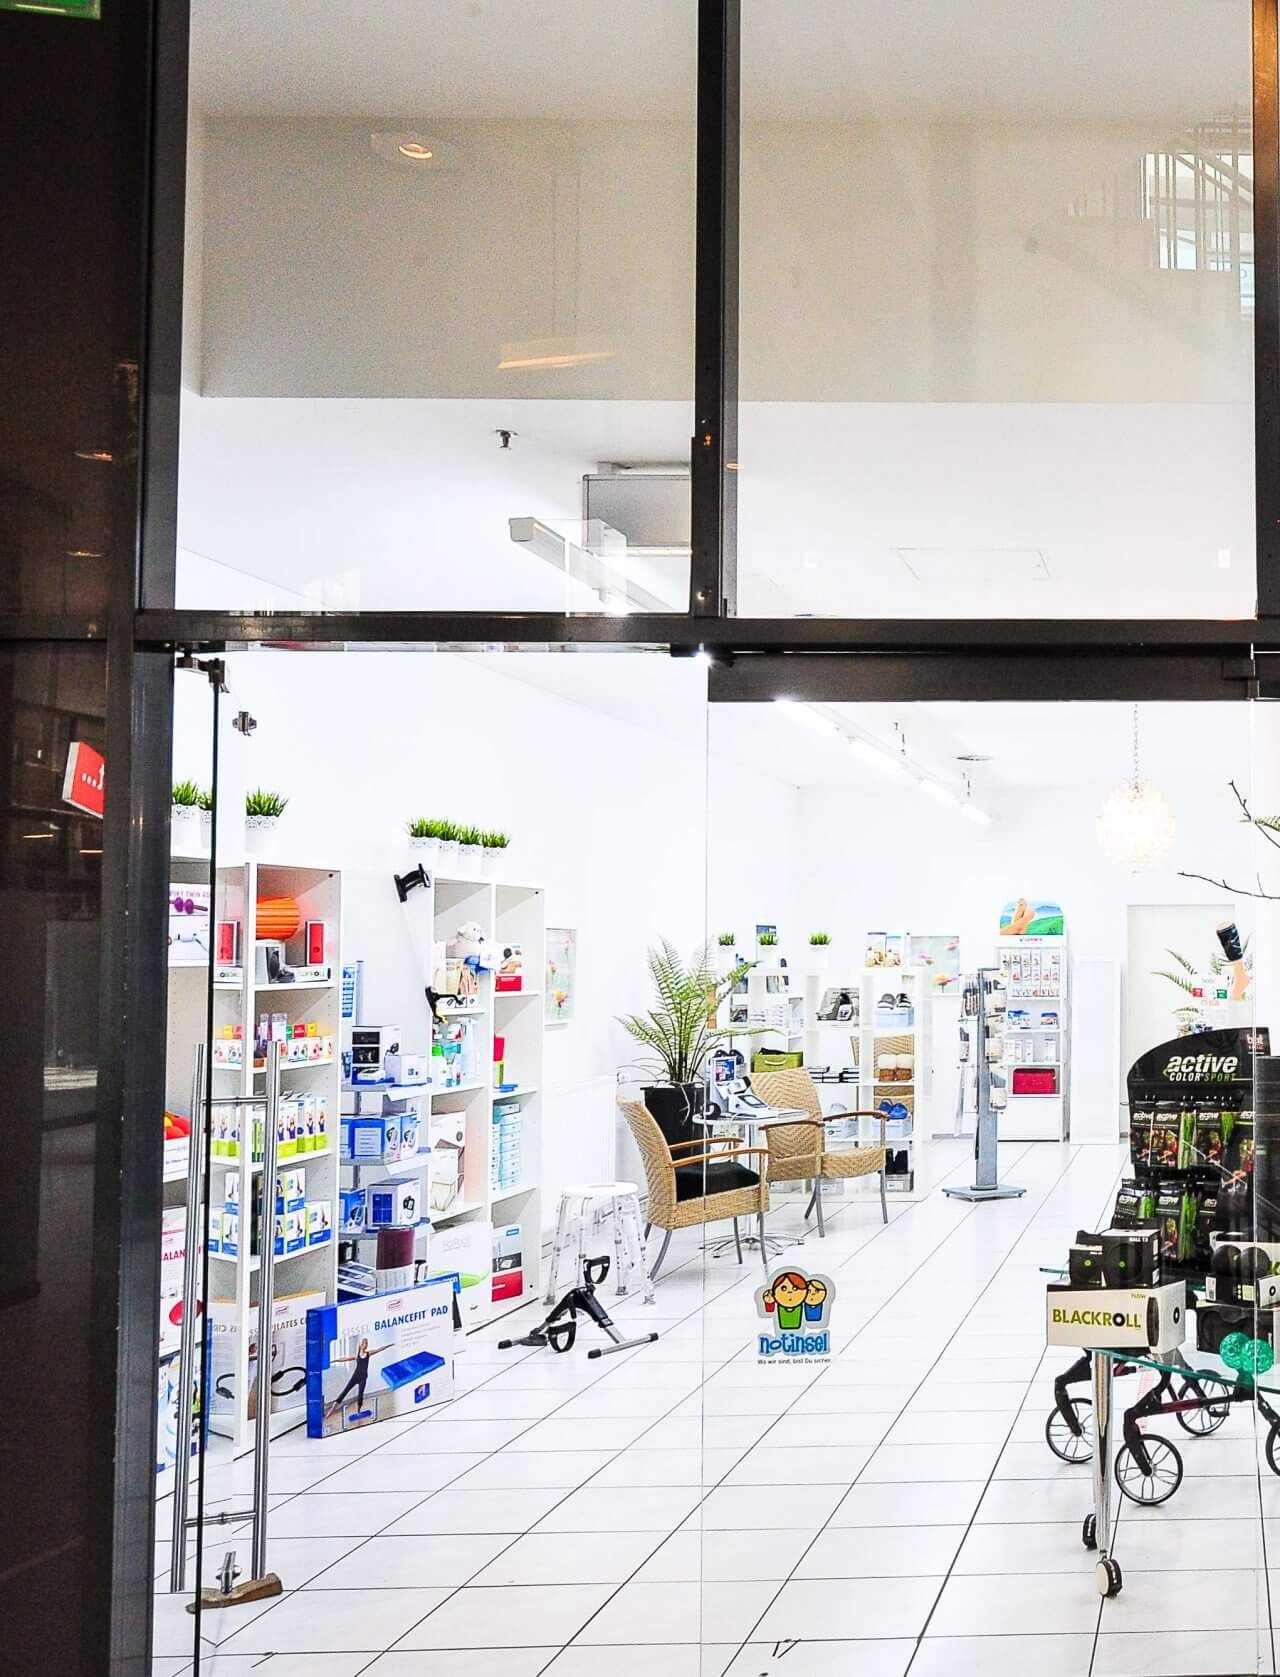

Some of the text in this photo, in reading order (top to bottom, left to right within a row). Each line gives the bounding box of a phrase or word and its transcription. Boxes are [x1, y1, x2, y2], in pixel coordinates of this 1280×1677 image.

[1167, 1053, 1239, 1073] active
[1204, 1072, 1236, 1082] SPORT
[374, 1309, 426, 1331] BALANCEFIT
[431, 1305, 449, 1317] PAD
[1052, 1308, 1141, 1328] BLACKROLL
[759, 1332, 827, 1354] notinsel
